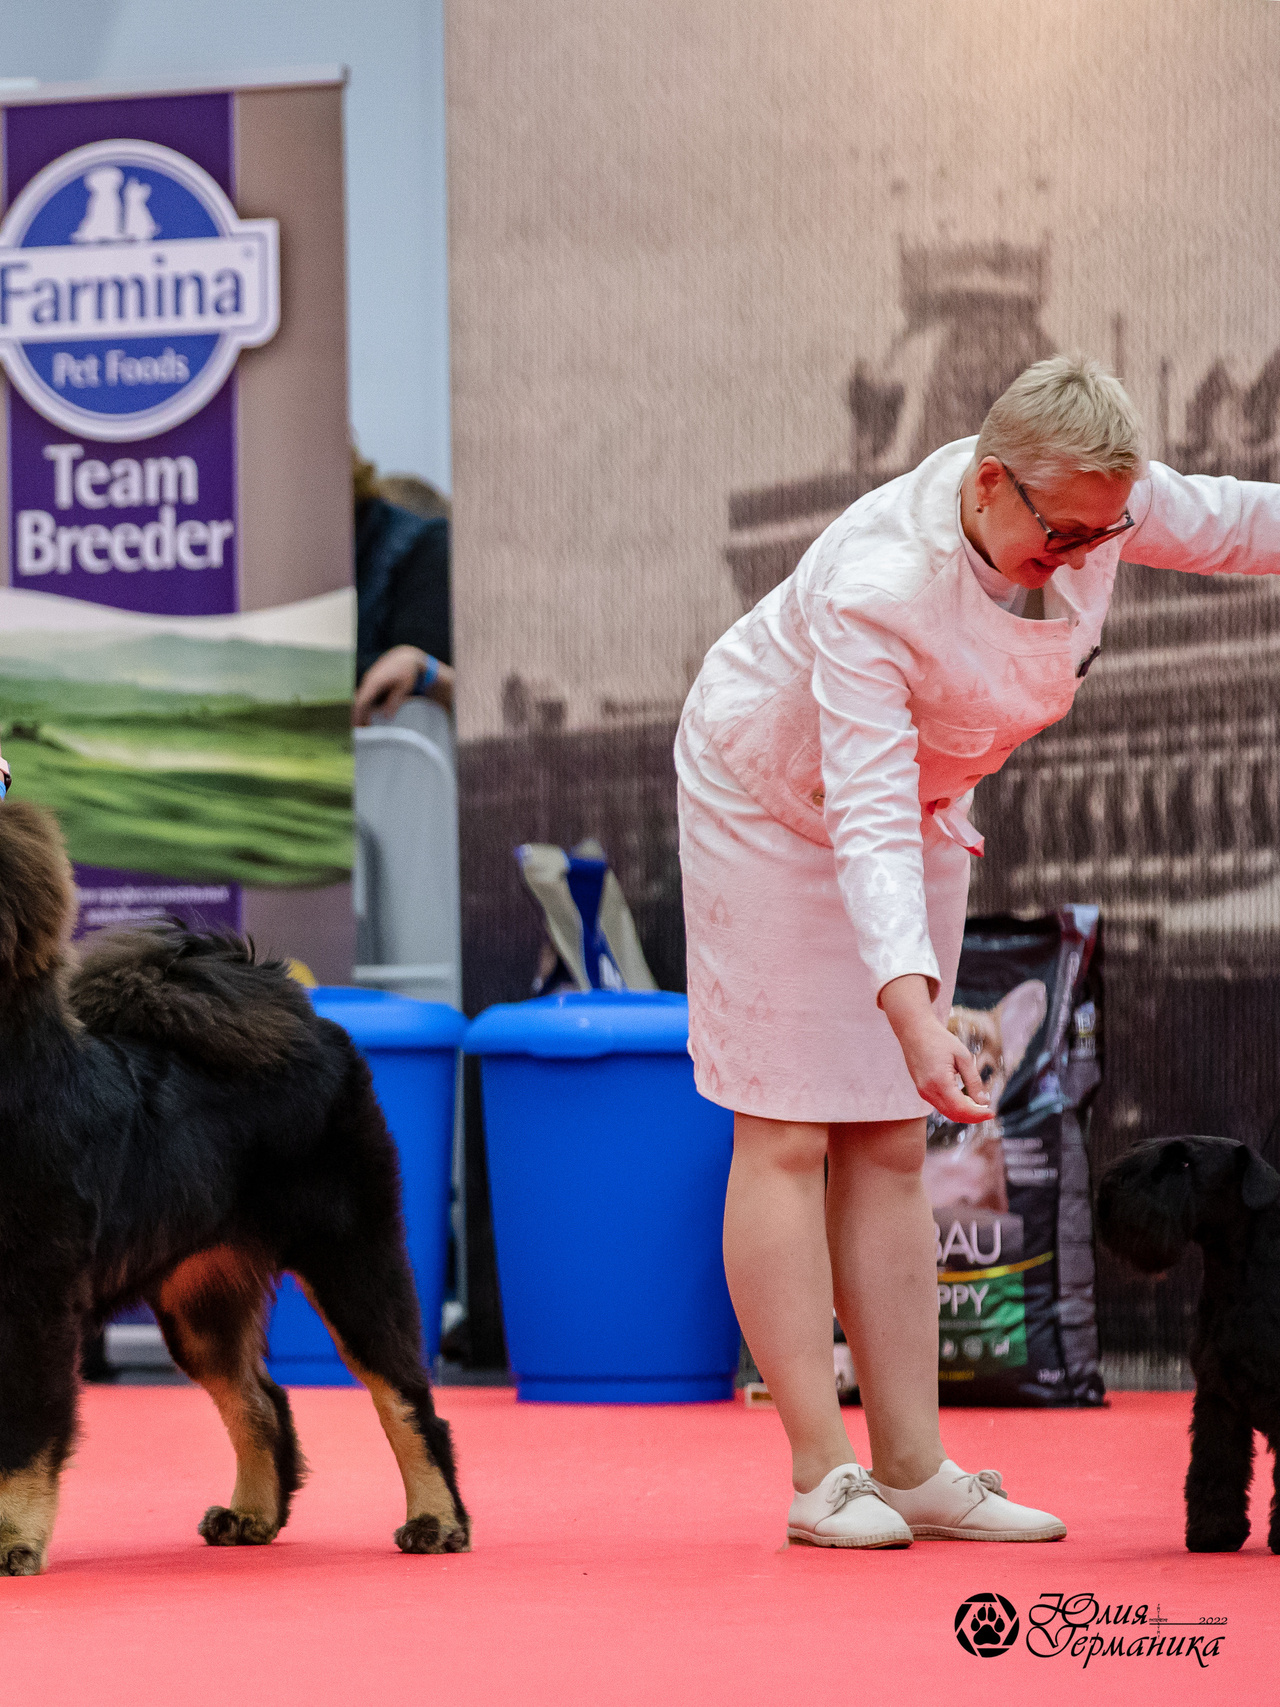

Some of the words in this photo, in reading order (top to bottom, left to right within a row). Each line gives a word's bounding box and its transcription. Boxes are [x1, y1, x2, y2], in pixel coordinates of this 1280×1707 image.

[53, 350, 100, 389] Pet
[106, 346, 191, 386] Foods
[42, 443, 198, 510] Team
[19, 504, 235, 575] Breeder
